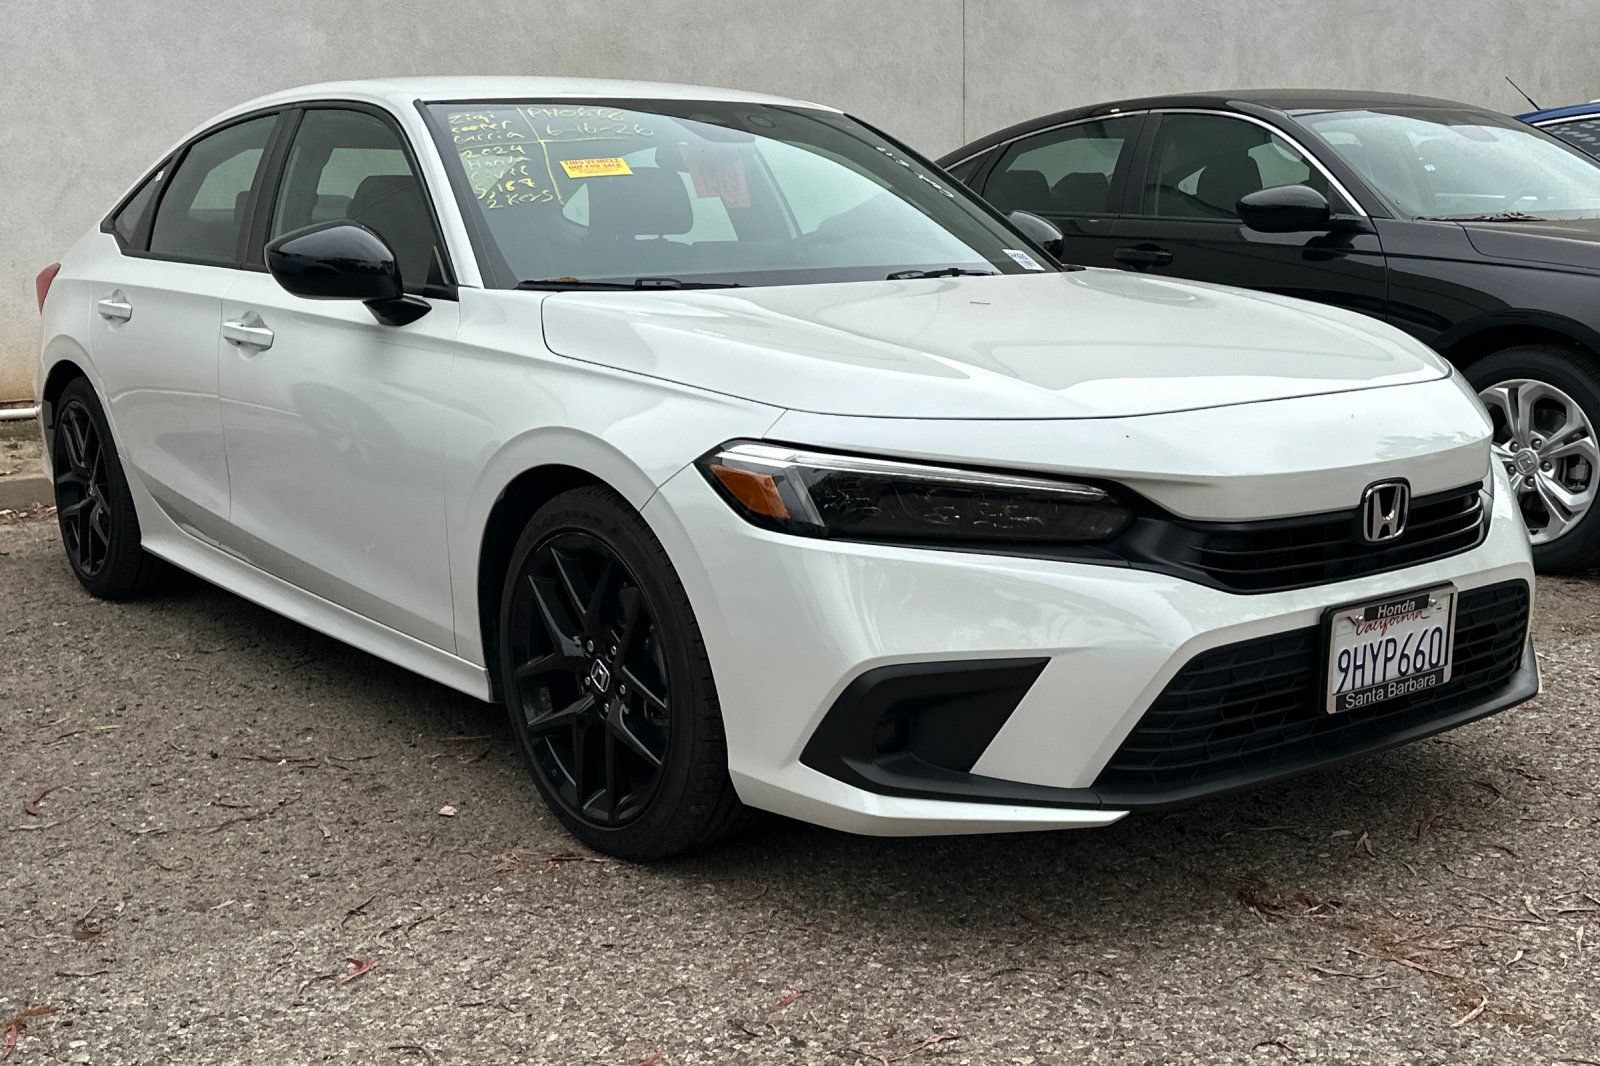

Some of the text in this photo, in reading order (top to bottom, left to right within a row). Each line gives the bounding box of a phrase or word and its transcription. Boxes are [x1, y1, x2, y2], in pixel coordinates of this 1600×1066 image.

[461, 145, 526, 158] 2024
[1377, 600, 1416, 619] Honda
[1336, 626, 1443, 695] 9HYP660
[1345, 674, 1437, 709] Santa Barbara
